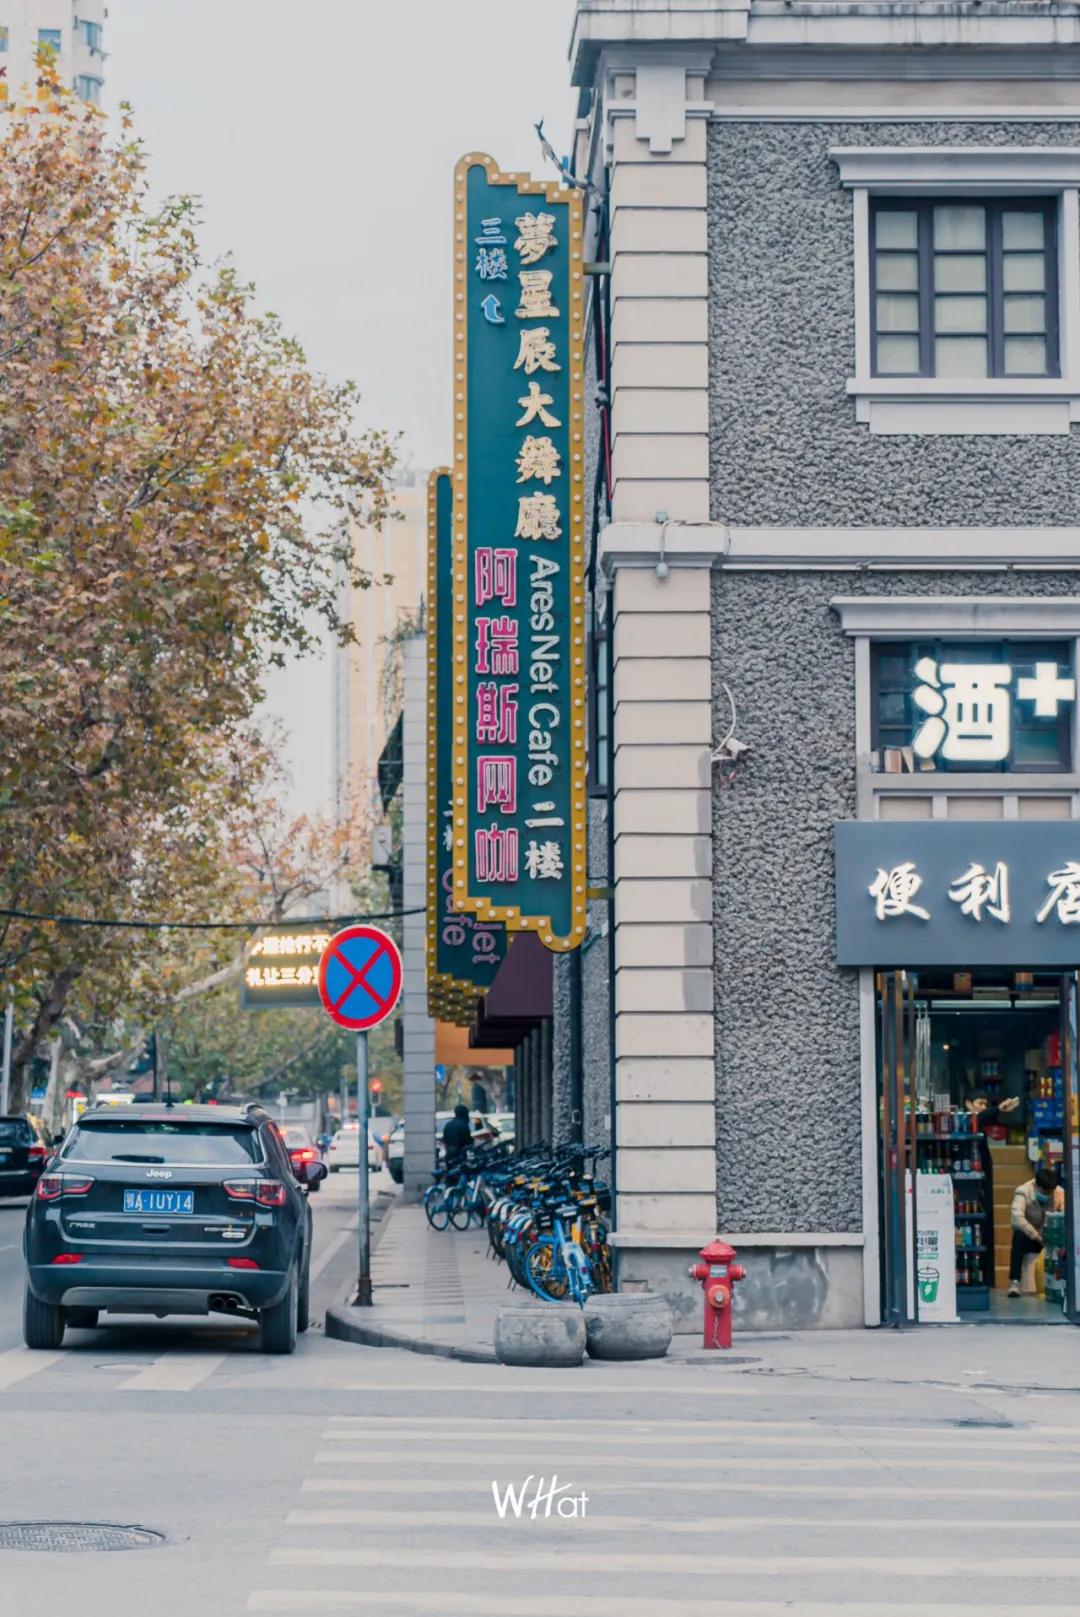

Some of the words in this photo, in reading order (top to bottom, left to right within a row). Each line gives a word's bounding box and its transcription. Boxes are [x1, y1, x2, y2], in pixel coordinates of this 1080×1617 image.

[474, 546, 519, 882] 阿瑞斯网咖
[528, 702, 560, 787] Cafe
[868, 861, 1080, 924] 便利店
[145, 1168, 173, 1180] Jeep
